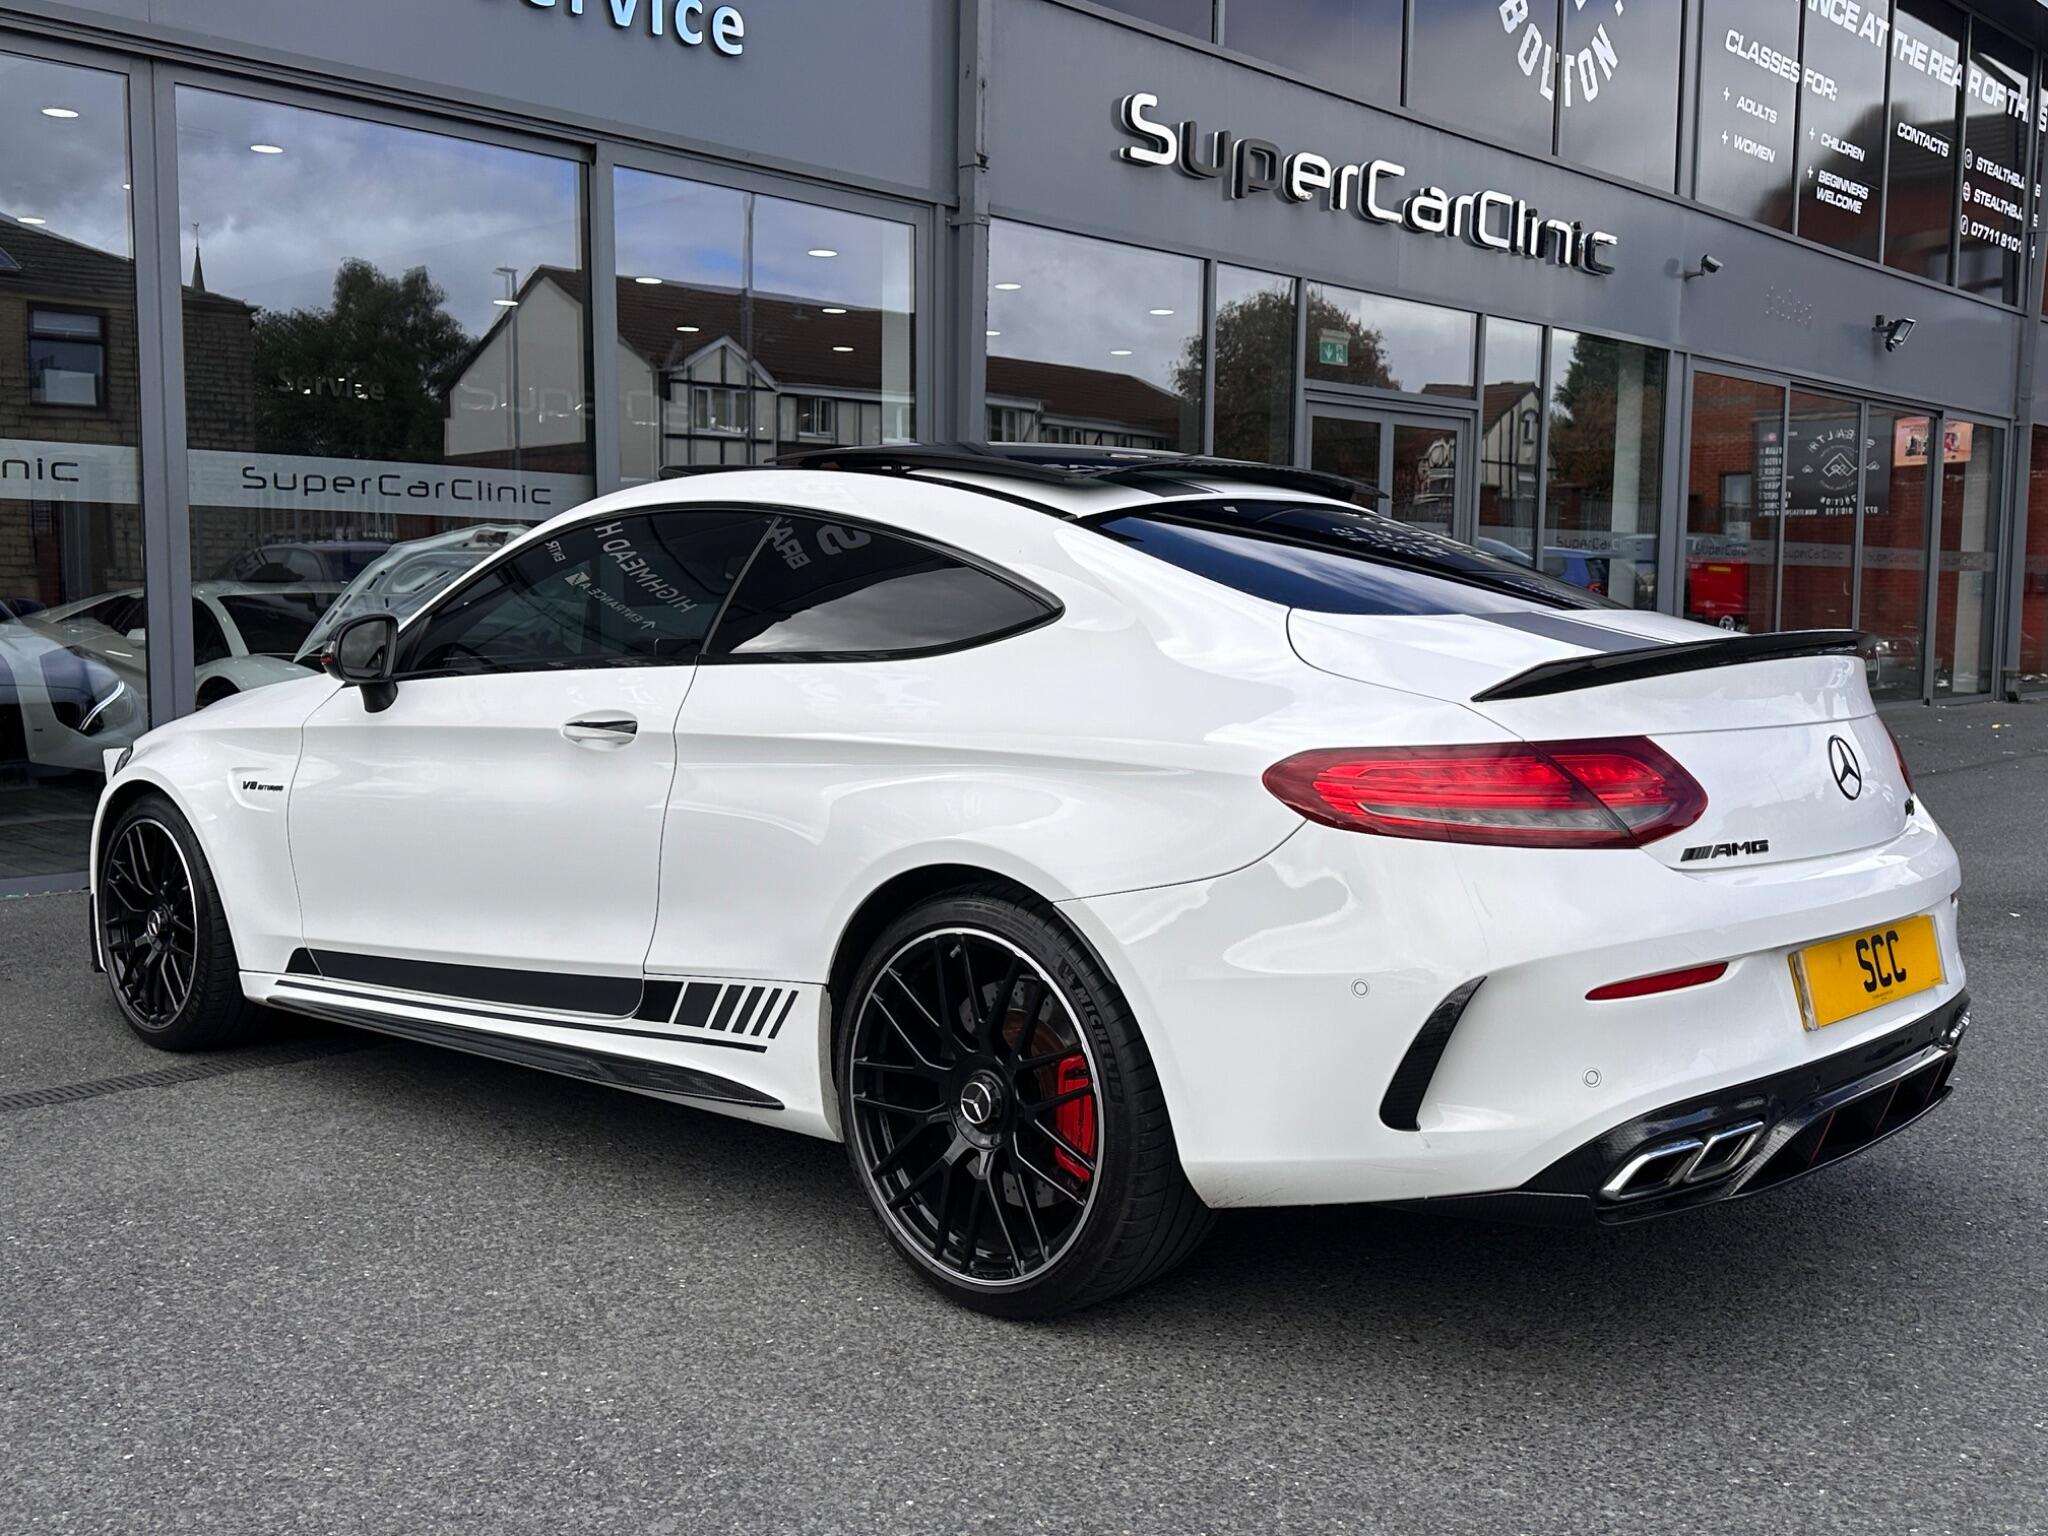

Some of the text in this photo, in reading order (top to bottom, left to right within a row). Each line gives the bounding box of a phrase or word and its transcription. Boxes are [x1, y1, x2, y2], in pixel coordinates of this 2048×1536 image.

[1499, 0, 1618, 107] BOLTON
[1725, 29, 1838, 101] CLASSES FOR:
[1858, 11, 1890, 47] AT
[1892, 29, 1929, 72] THE
[1927, 49, 1982, 98] REAR
[1981, 76, 2007, 107] OF
[2007, 88, 2029, 123] TH
[1736, 96, 1778, 124] ADULTS
[1733, 134, 1776, 163] WOMEN
[1820, 133, 1866, 162] CHILDREN
[1897, 122, 1950, 157] CONTACTS
[1119, 93, 1618, 275] SuperCarClinic
[1817, 170, 1869, 200] BEGINNERS
[1816, 187, 1863, 214] WELCOME
[1971, 222, 2000, 244] 07711
[242, 466, 551, 505] SuperCarClinic
[242, 780, 258, 790] V8
[1710, 839, 1769, 859] AMG
[1855, 930, 1908, 993] SCC
